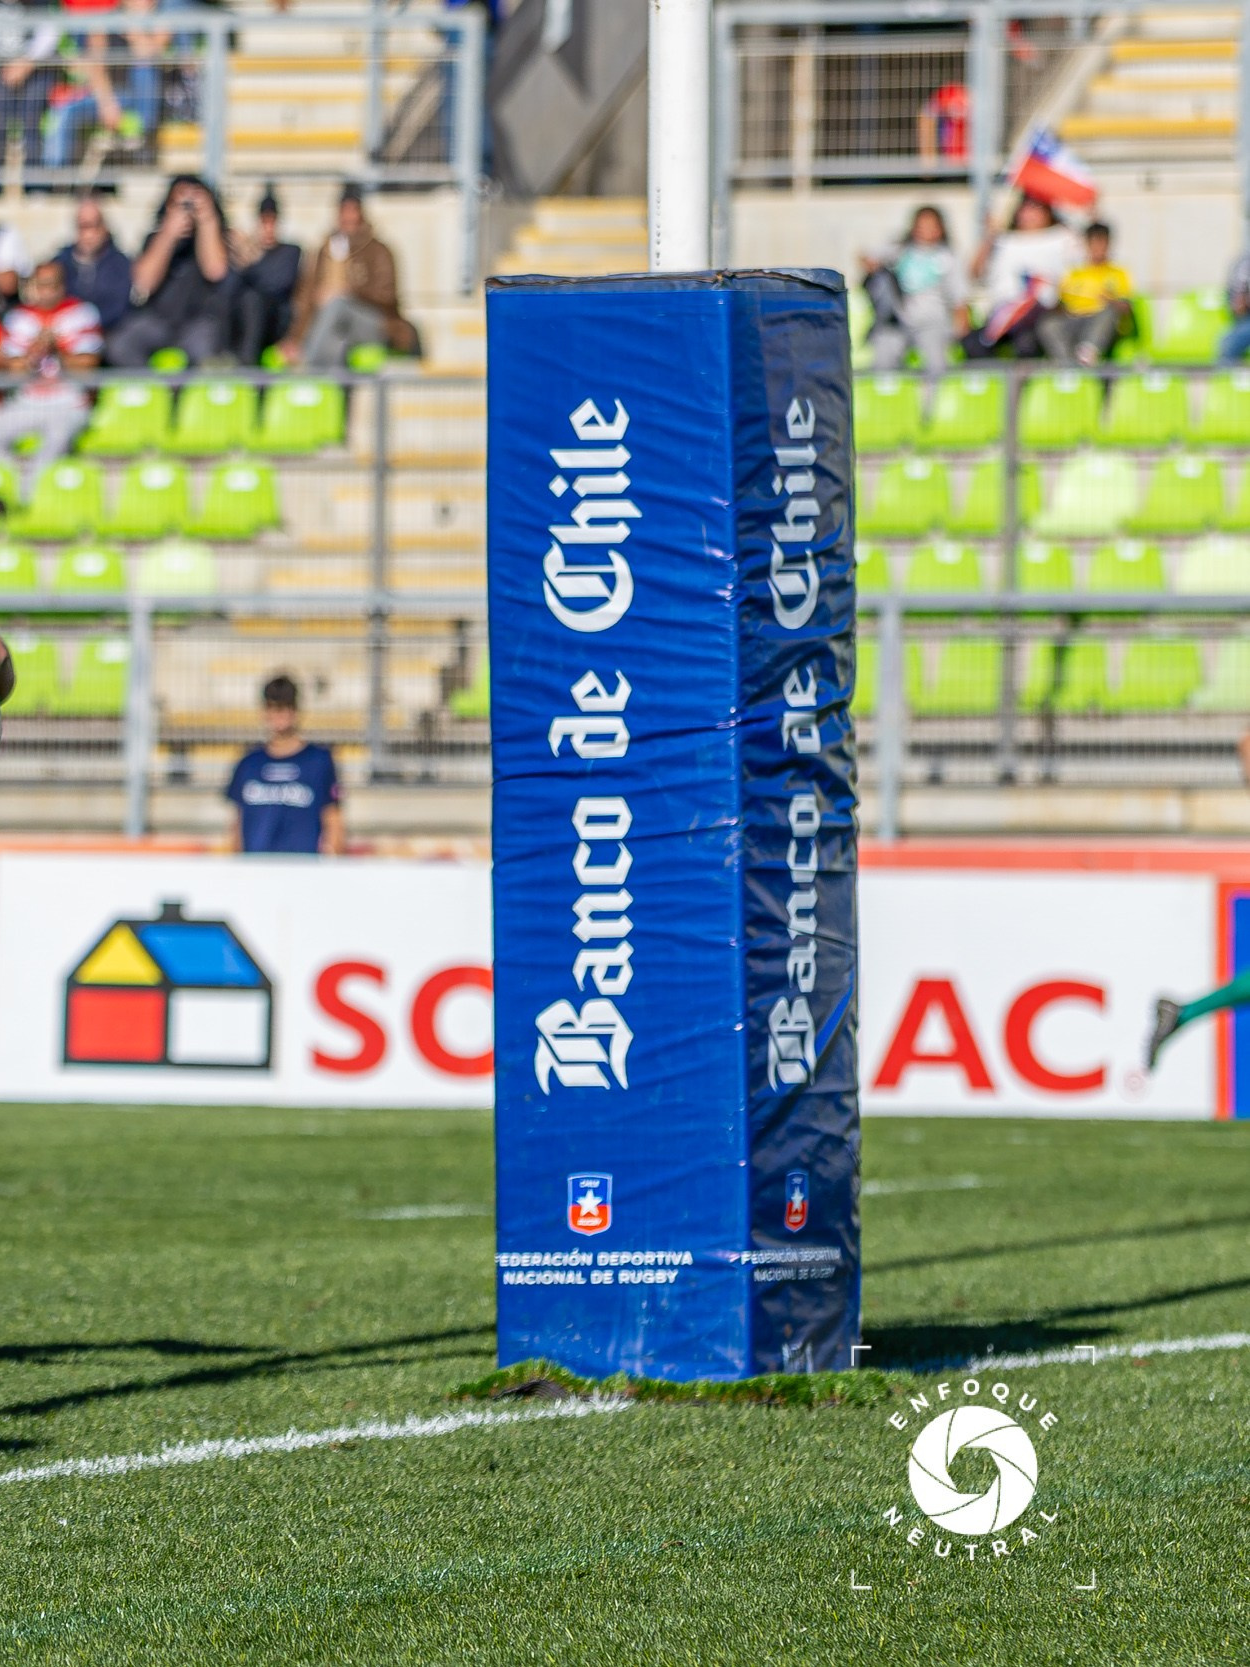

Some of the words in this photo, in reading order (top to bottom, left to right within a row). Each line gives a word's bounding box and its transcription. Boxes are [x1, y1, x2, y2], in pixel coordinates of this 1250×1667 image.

[543, 399, 642, 632] Chile
[767, 397, 821, 629] Chile
[548, 671, 632, 759] de
[782, 667, 821, 754] de
[535, 797, 633, 1094] Banco
[768, 794, 821, 1089] Banco
[503, 1270, 587, 1285] NACIONAL
[590, 1270, 614, 1284] DE
[618, 1269, 678, 1284] RUGBY
[597, 1250, 694, 1266] DEPORTIVA
